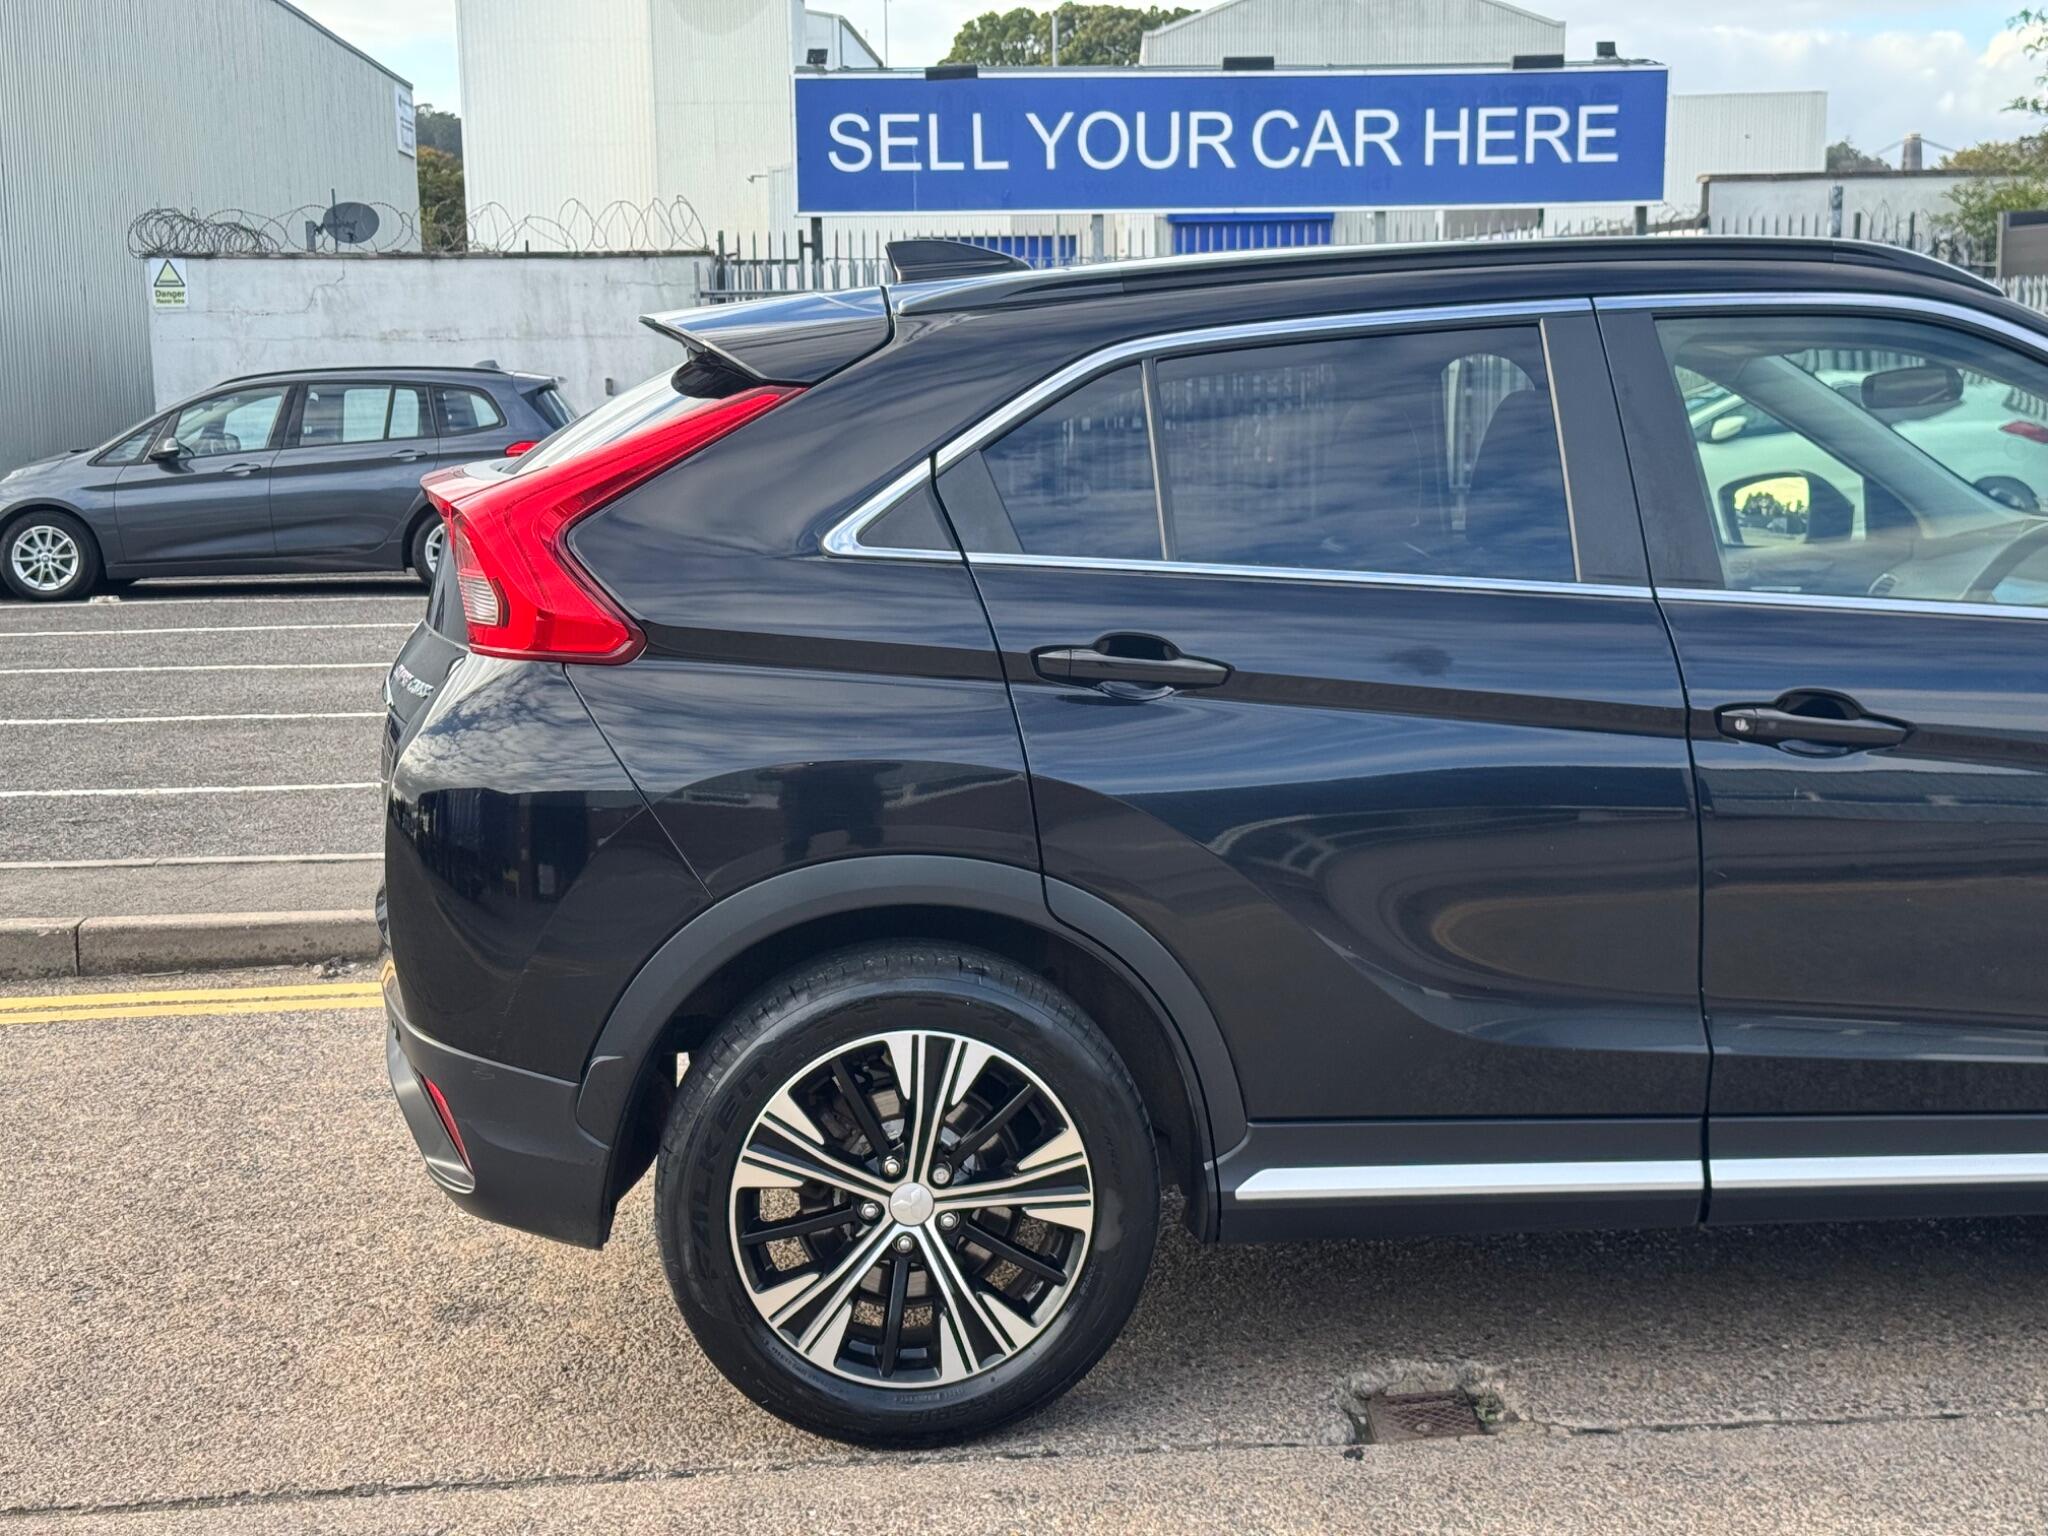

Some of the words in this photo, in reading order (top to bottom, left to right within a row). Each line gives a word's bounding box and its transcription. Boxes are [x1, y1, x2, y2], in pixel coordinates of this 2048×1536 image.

[828, 112, 1009, 172] SELL
[1025, 110, 1236, 170] YOUR
[1251, 108, 1402, 169] CAR
[1425, 104, 1619, 166] HERE
[155, 290, 185, 299] Danger
